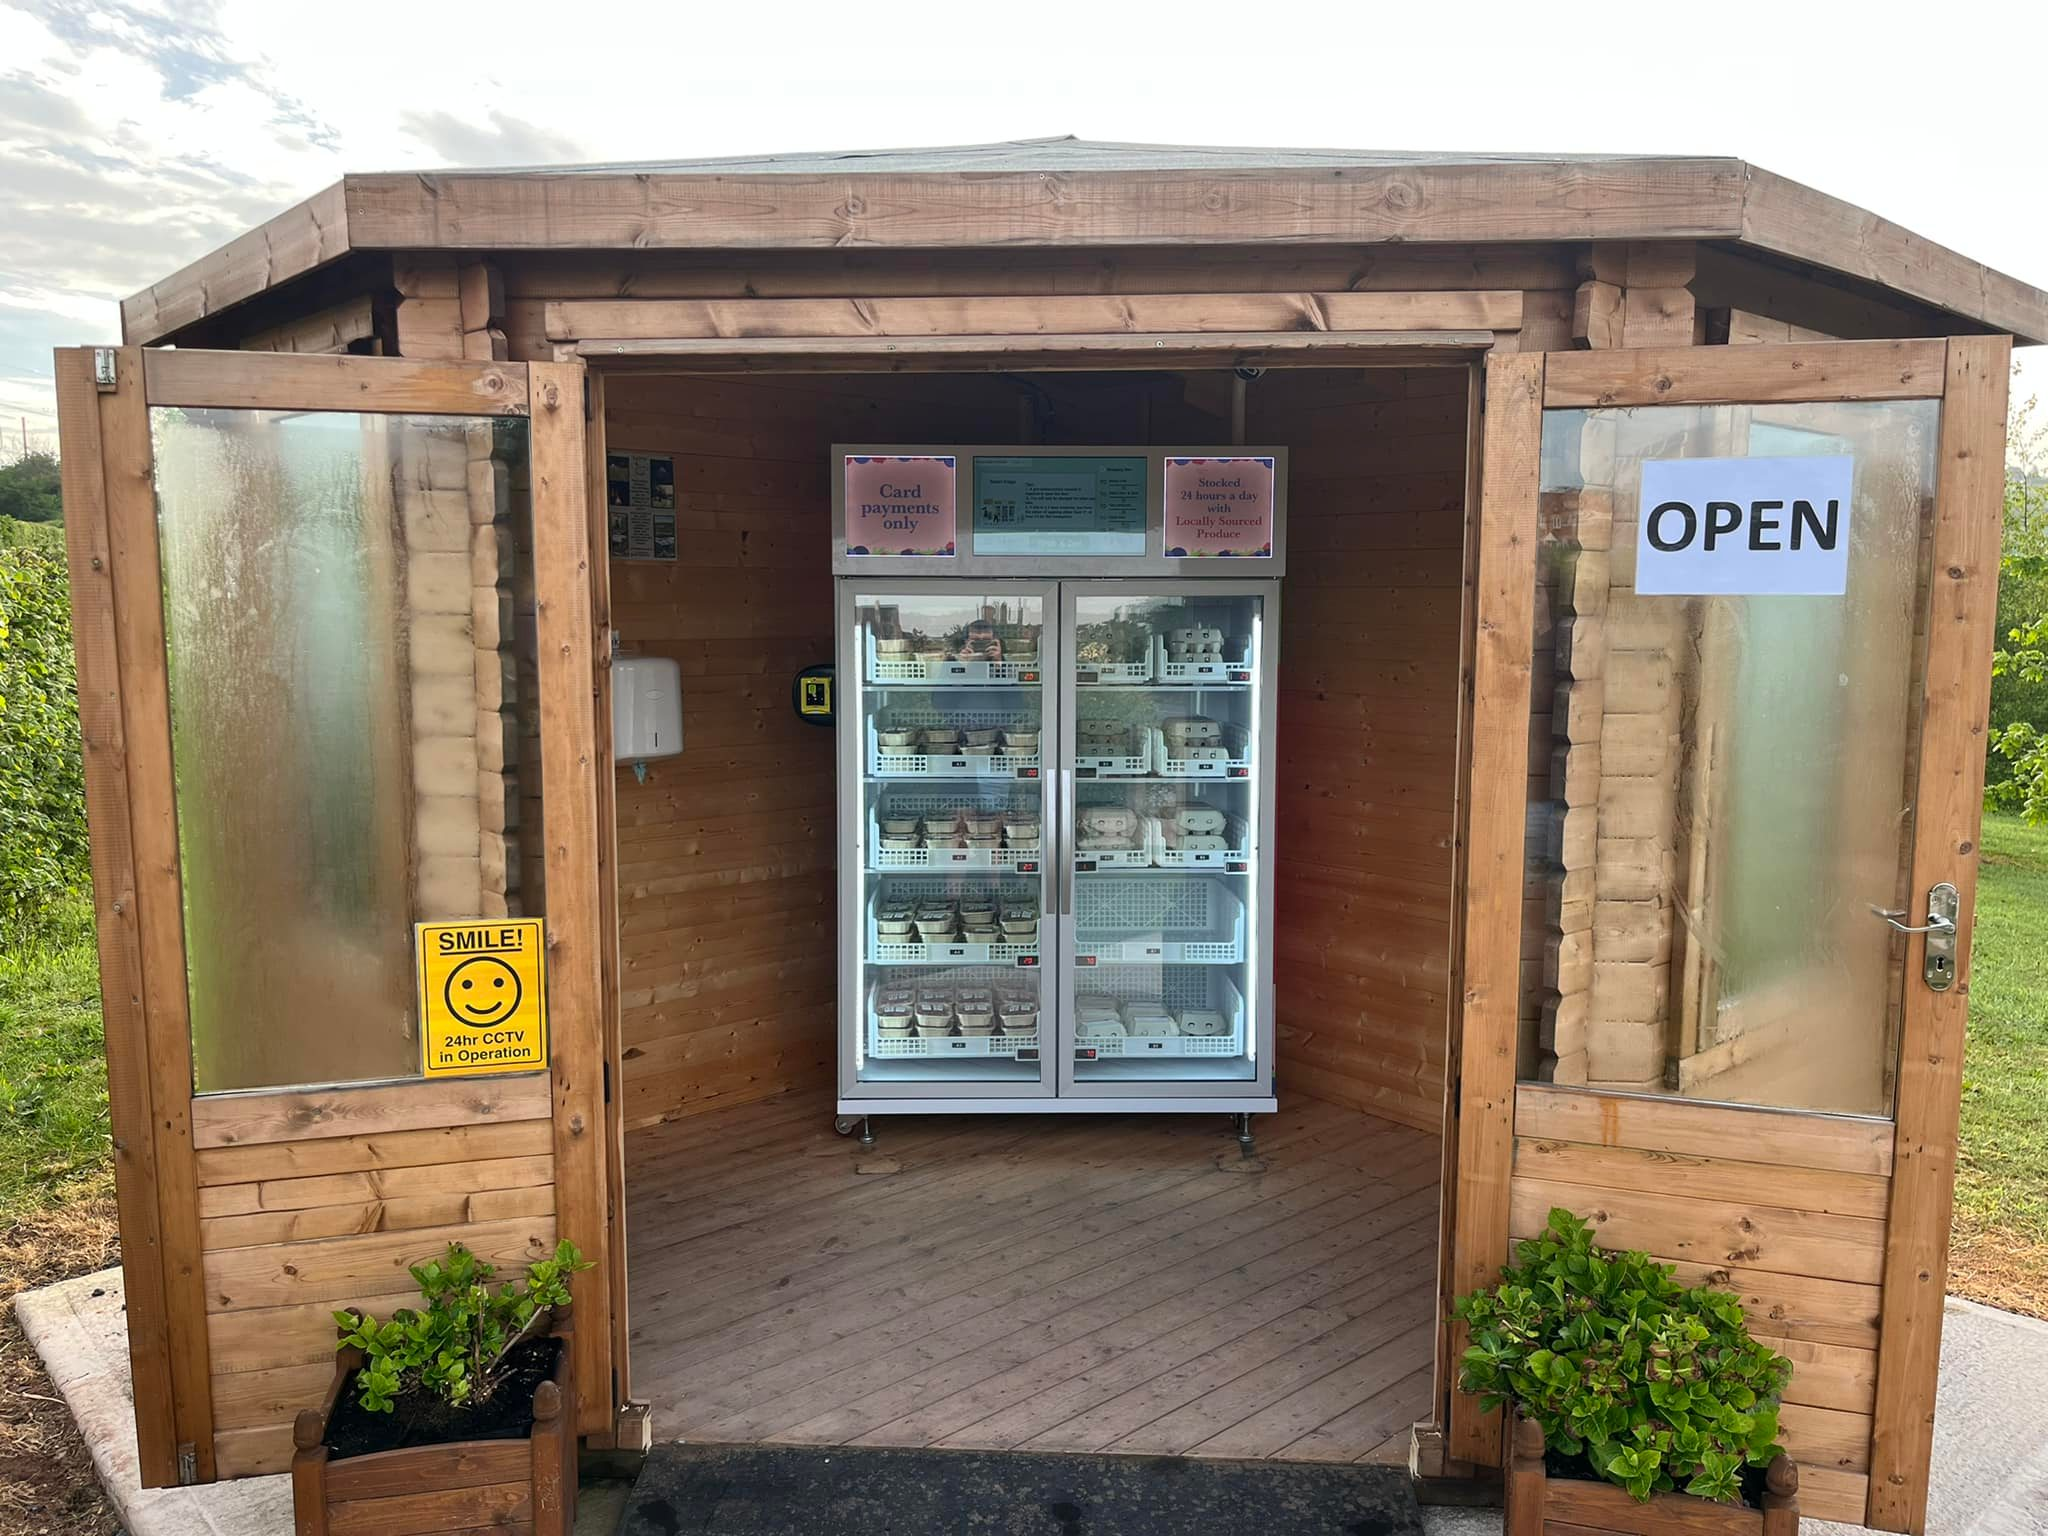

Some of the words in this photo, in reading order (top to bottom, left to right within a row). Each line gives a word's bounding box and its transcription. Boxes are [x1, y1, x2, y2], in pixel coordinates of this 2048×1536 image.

[1199, 478, 1240, 488] Stocked
[880, 484, 921, 498] Card
[1181, 491, 1192, 500] 24
[1196, 491, 1225, 500] hours
[1239, 490, 1258, 502] day
[861, 503, 940, 518] payments
[1207, 504, 1231, 513] with
[883, 516, 919, 534] only
[1176, 516, 1215, 528] Locally
[1218, 516, 1262, 526] Sourced
[1647, 500, 1838, 552] OPEN
[1197, 529, 1241, 538] Produce
[439, 929, 522, 950] SMILE!
[445, 1035, 478, 1047] 24hr
[482, 1031, 524, 1045] CCTV
[440, 1052, 453, 1063] in
[458, 1047, 531, 1063] Operation
